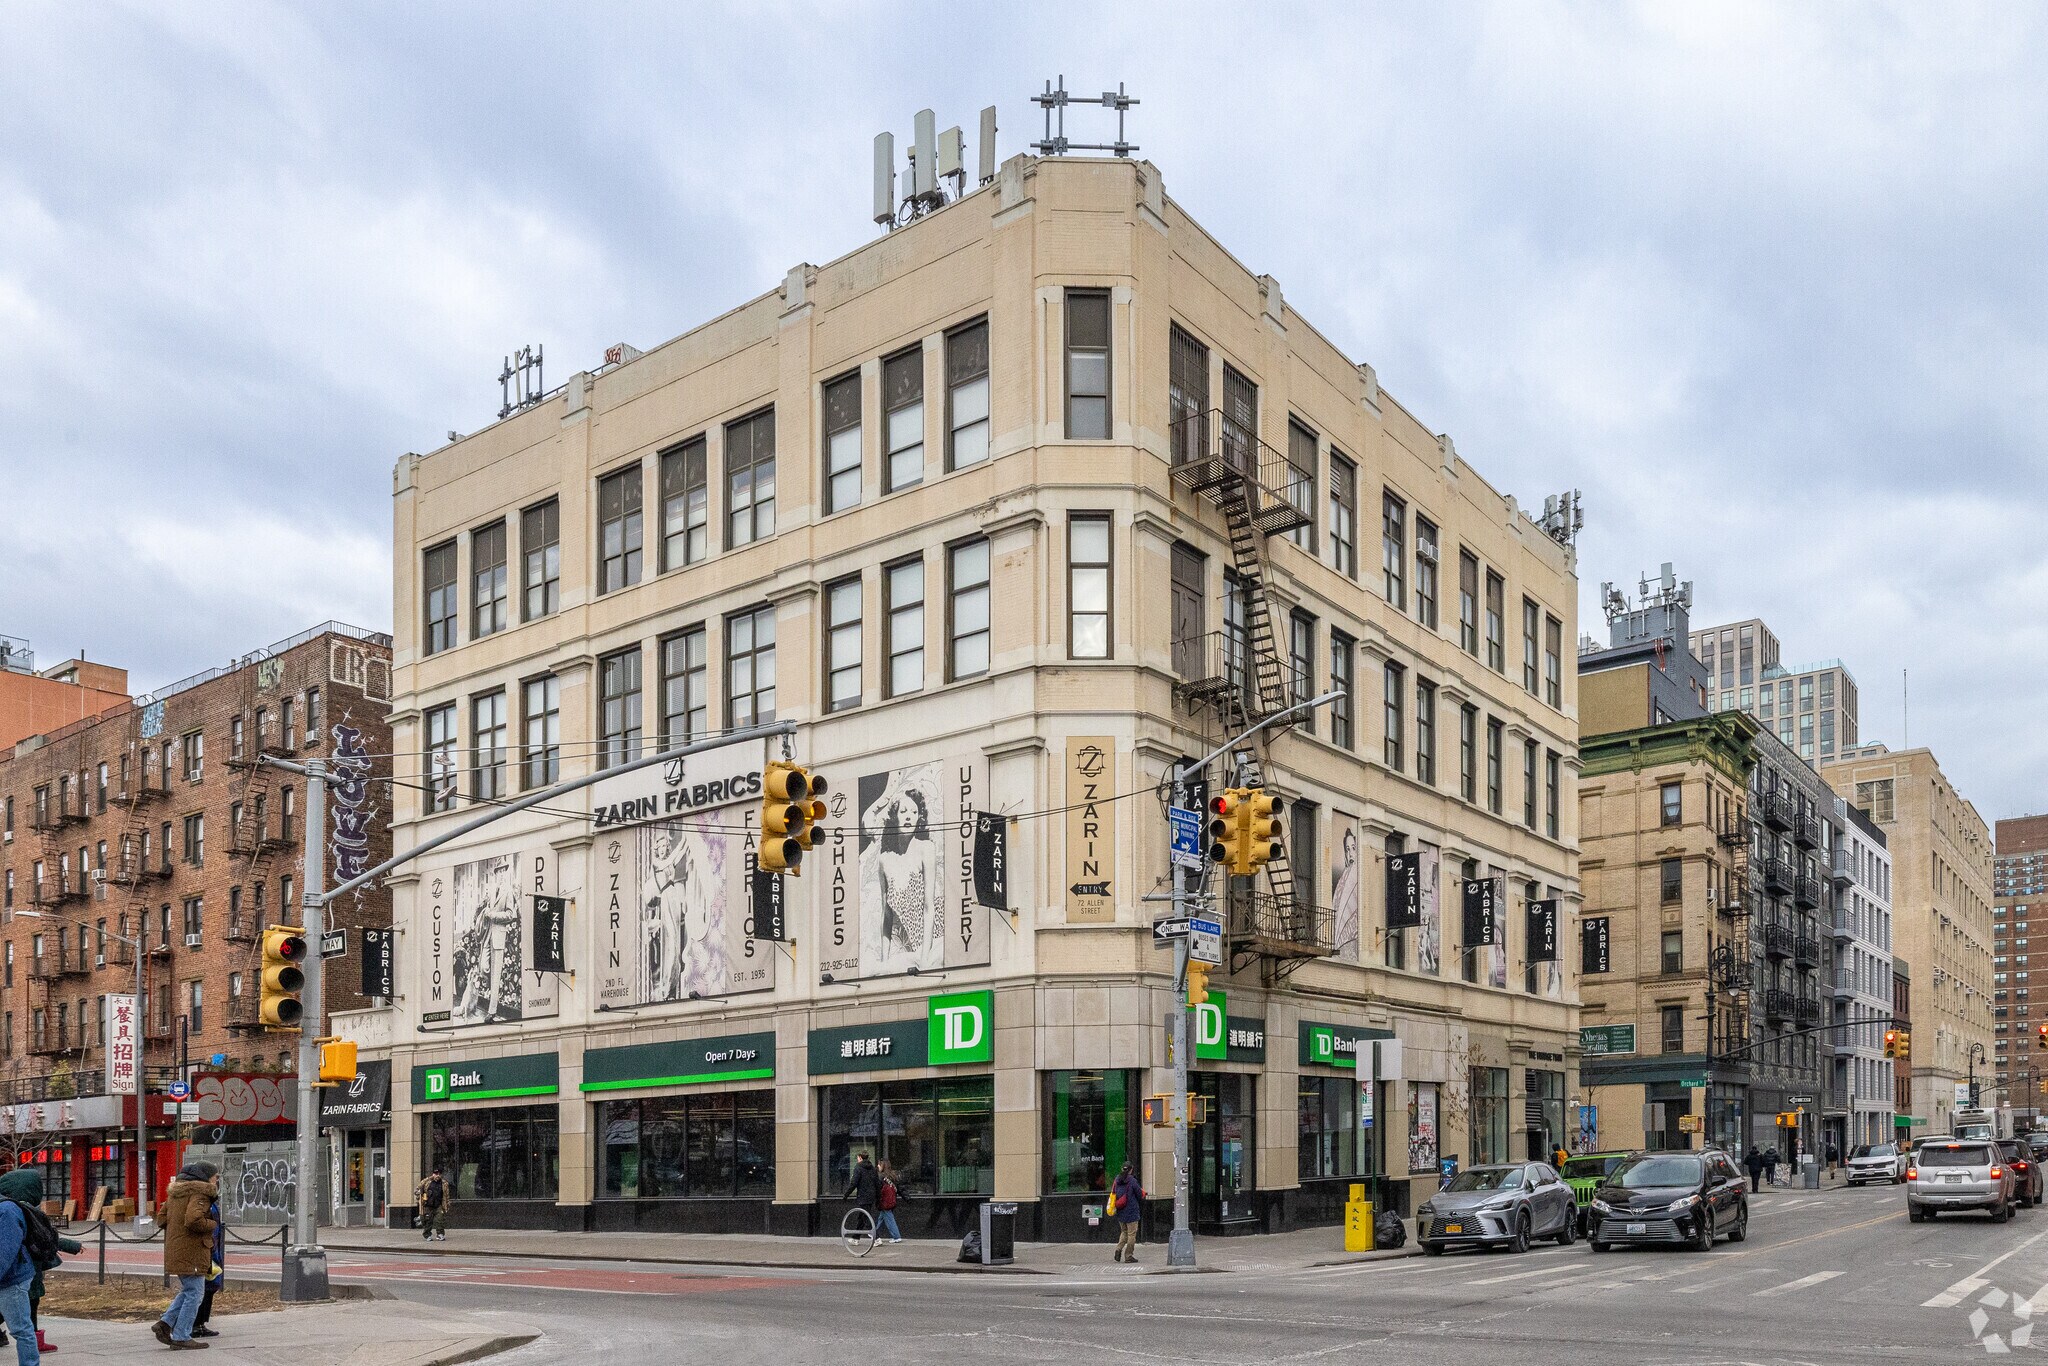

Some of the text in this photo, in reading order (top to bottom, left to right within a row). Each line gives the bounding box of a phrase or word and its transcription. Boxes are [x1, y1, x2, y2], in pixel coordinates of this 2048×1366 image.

[331, 724, 371, 888] LOVE
[594, 771, 762, 827] ZARIN FABRICS
[1172, 810, 1183, 818] PARK
[1083, 784, 1099, 876] ZARIN
[1180, 830, 1195, 839] PARKING
[959, 765, 972, 952] UPHOLSTERY
[993, 833, 1002, 893] ZARIN
[743, 809, 755, 958] FABRICS
[832, 826, 845, 946] SHADES
[1078, 885, 1103, 894] ENTRY
[1407, 867, 1416, 914] ZARIN
[771, 872, 781, 938] ABRICS
[1080, 907, 1101, 915] STREET
[1482, 881, 1490, 943] FABRICS
[609, 873, 620, 968] ZARIN
[1161, 923, 1189, 933] ONE WA
[1197, 922, 1219, 933] BUS LANE
[324, 938, 341, 951] WAY
[551, 912, 559, 959] ZARIN
[381, 932, 390, 995] FABRICS
[432, 905, 442, 1001] CUSTOM
[820, 958, 858, 972] 212-925-6112
[605, 977, 625, 988] 2ND FL
[733, 969, 766, 983] EST. 1936
[528, 998, 551, 1008] SHOWROOM
[600, 987, 629, 998] WAREHOUSE
[428, 1012, 449, 1021] ENTER HERE
[934, 1005, 983, 1050] TD
[113, 1006, 135, 1079] 餐具招牌
[841, 1037, 891, 1058] 道明銀行
[1229, 1029, 1264, 1048] 道明銀行
[1316, 1033, 1357, 1056] TD Bank
[705, 1049, 756, 1063] Open 7 Days
[112, 1080, 134, 1091] Sign
[427, 1071, 481, 1093] TD Bank
[322, 1102, 381, 1115] ZARIN FABRICS
